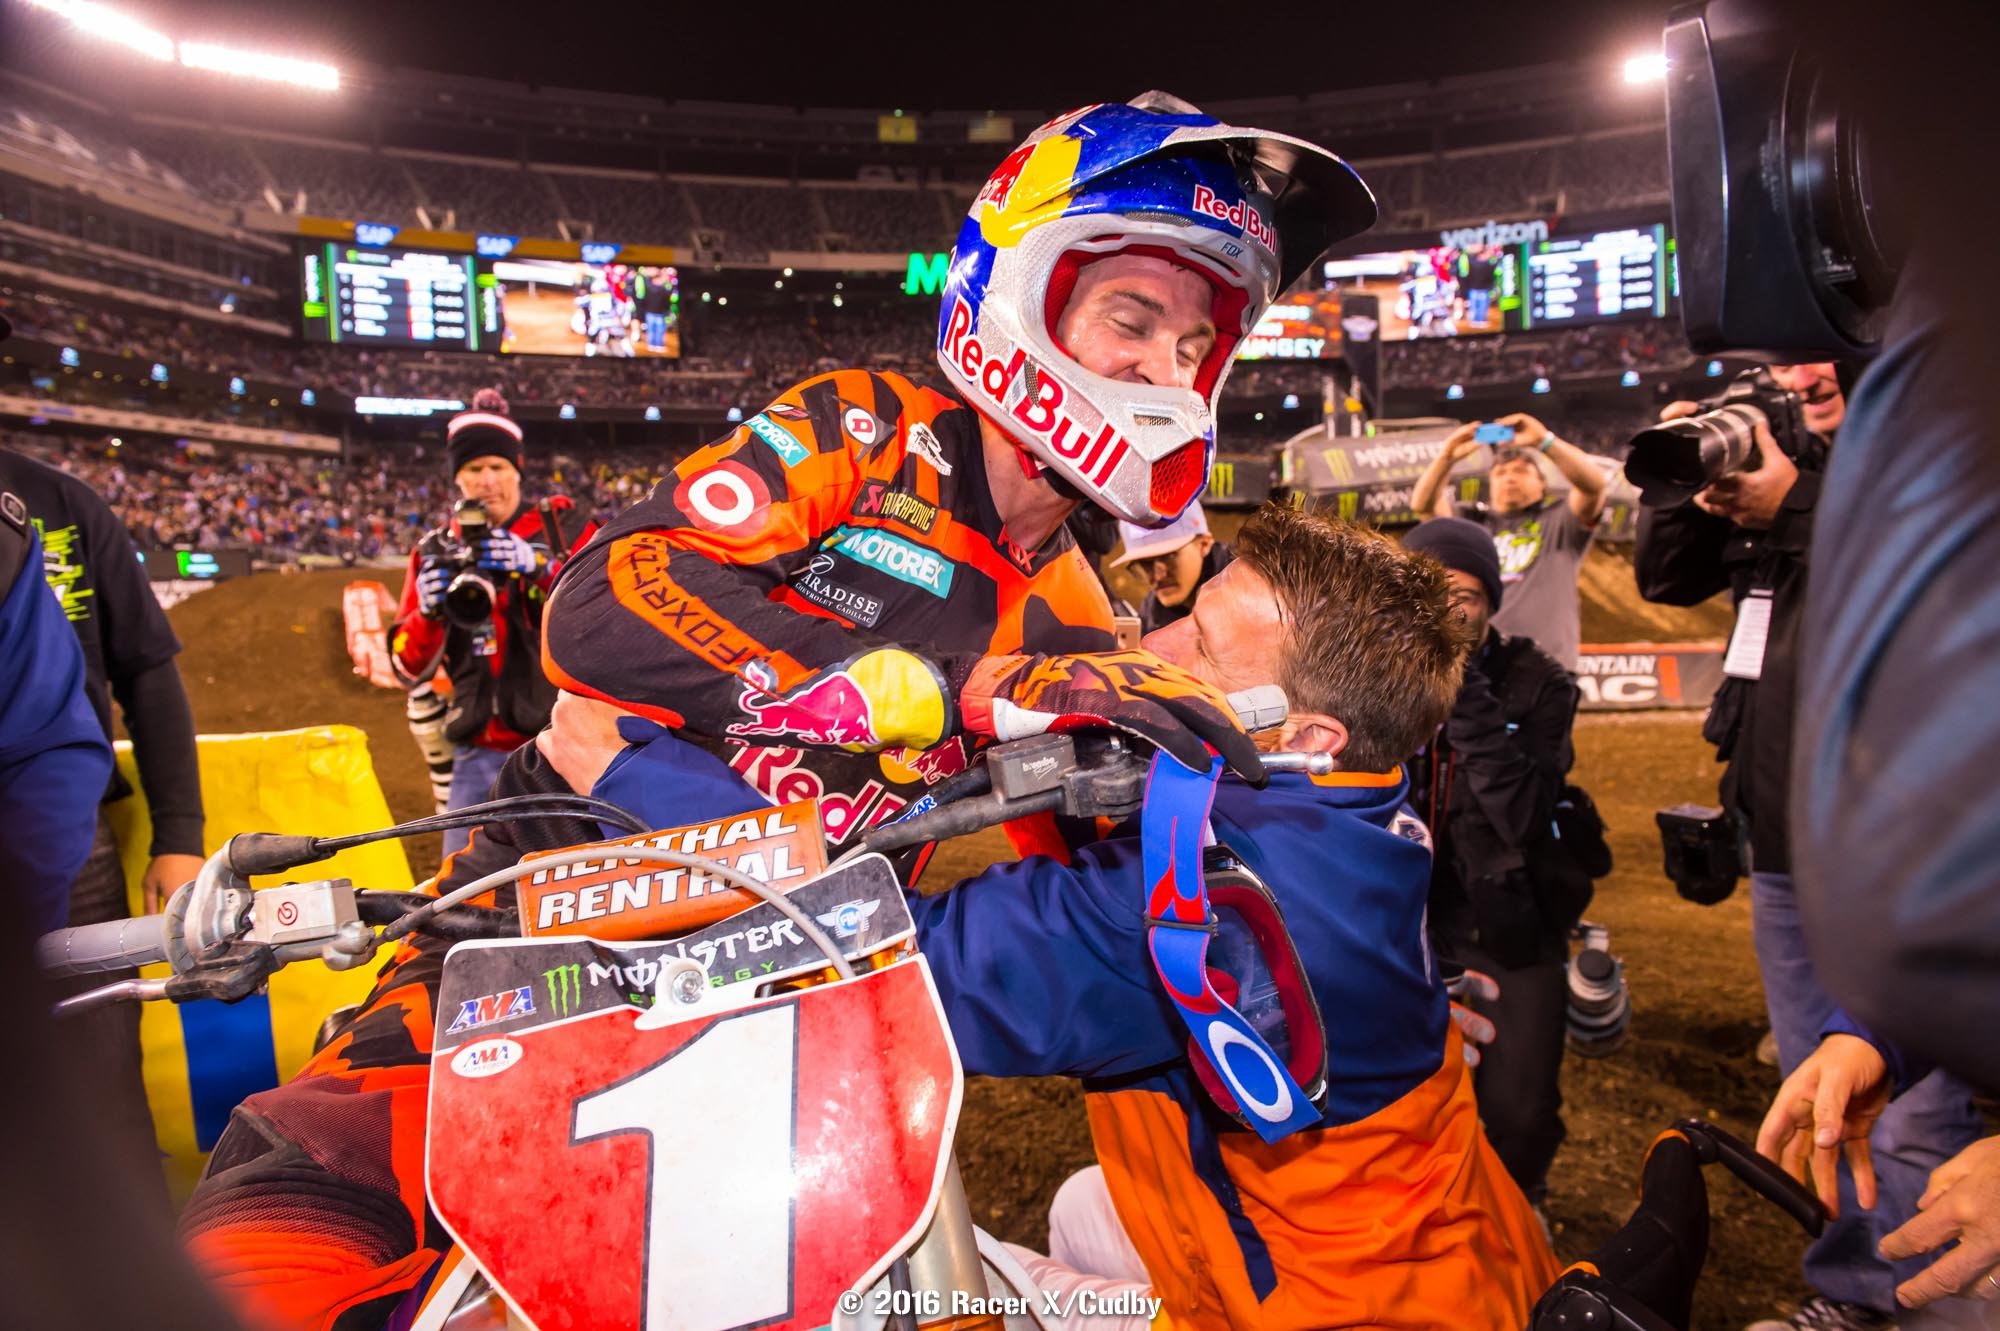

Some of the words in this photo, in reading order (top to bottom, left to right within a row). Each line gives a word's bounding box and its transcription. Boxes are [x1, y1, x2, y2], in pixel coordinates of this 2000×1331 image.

[1193, 184, 1246, 230] Red
[1246, 205, 1277, 256] Bull
[1221, 242, 1244, 259] FOX
[942, 297, 1028, 406] Red
[1011, 367, 1132, 490] Bull
[835, 603, 873, 624] CADILLAC
[537, 846, 805, 930] RENTHAL
[445, 985, 537, 1034] AMA
[463, 1045, 509, 1069] AMA
[570, 998, 797, 1331] 1
